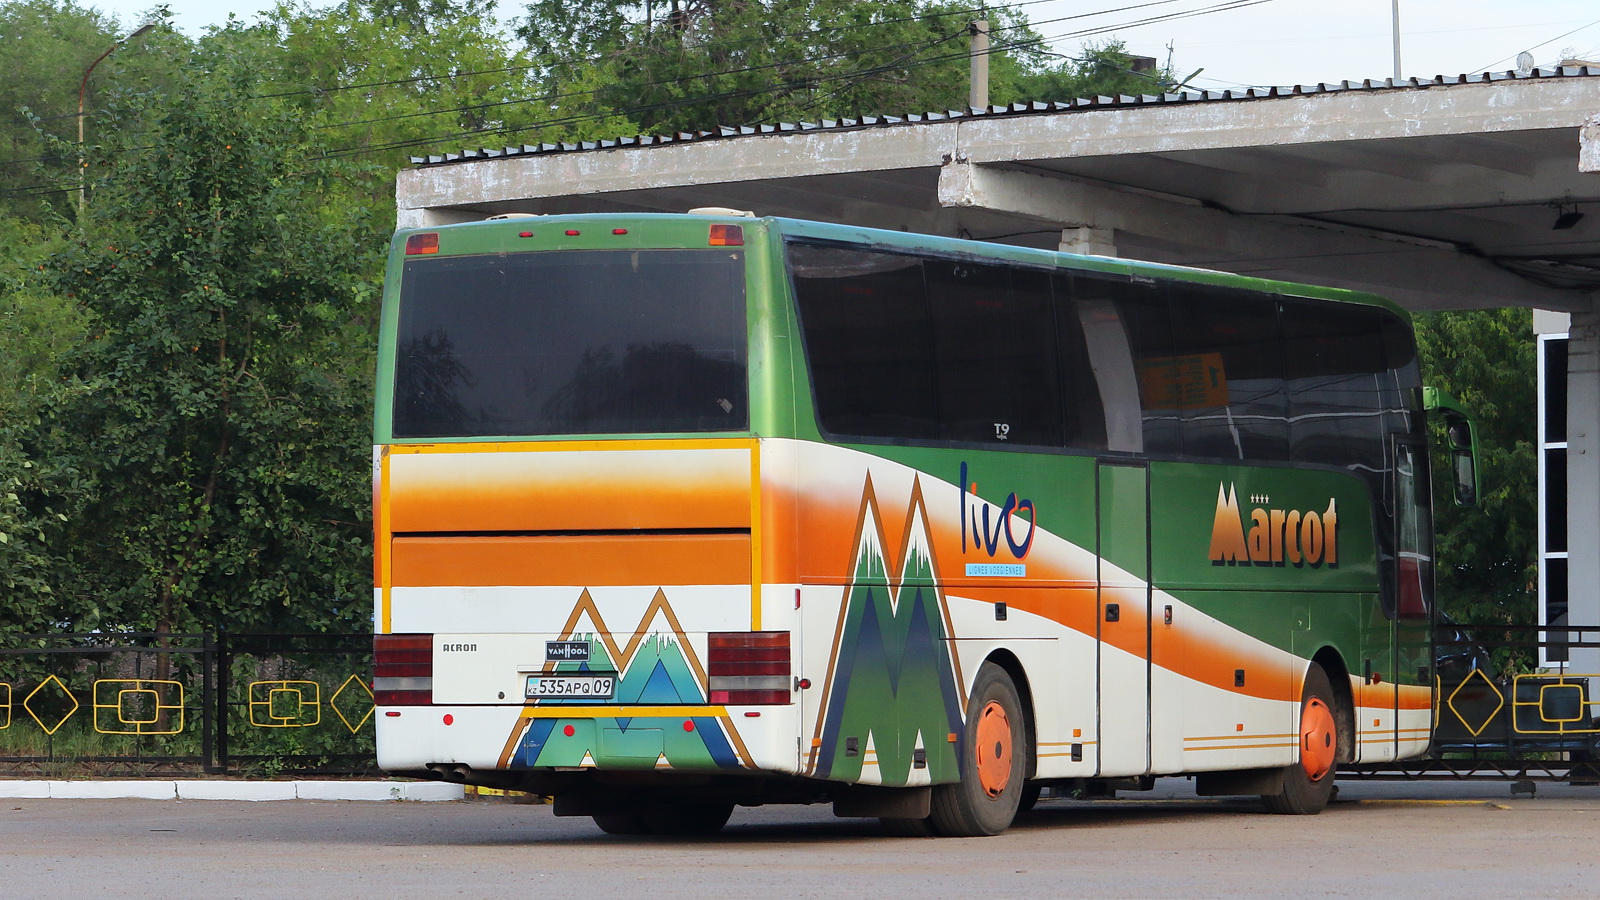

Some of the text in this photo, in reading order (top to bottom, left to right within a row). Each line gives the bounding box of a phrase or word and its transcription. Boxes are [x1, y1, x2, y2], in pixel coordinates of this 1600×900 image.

[993, 423, 1010, 435] T9
[968, 565, 1023, 576] LIGNES VOSGIENNES
